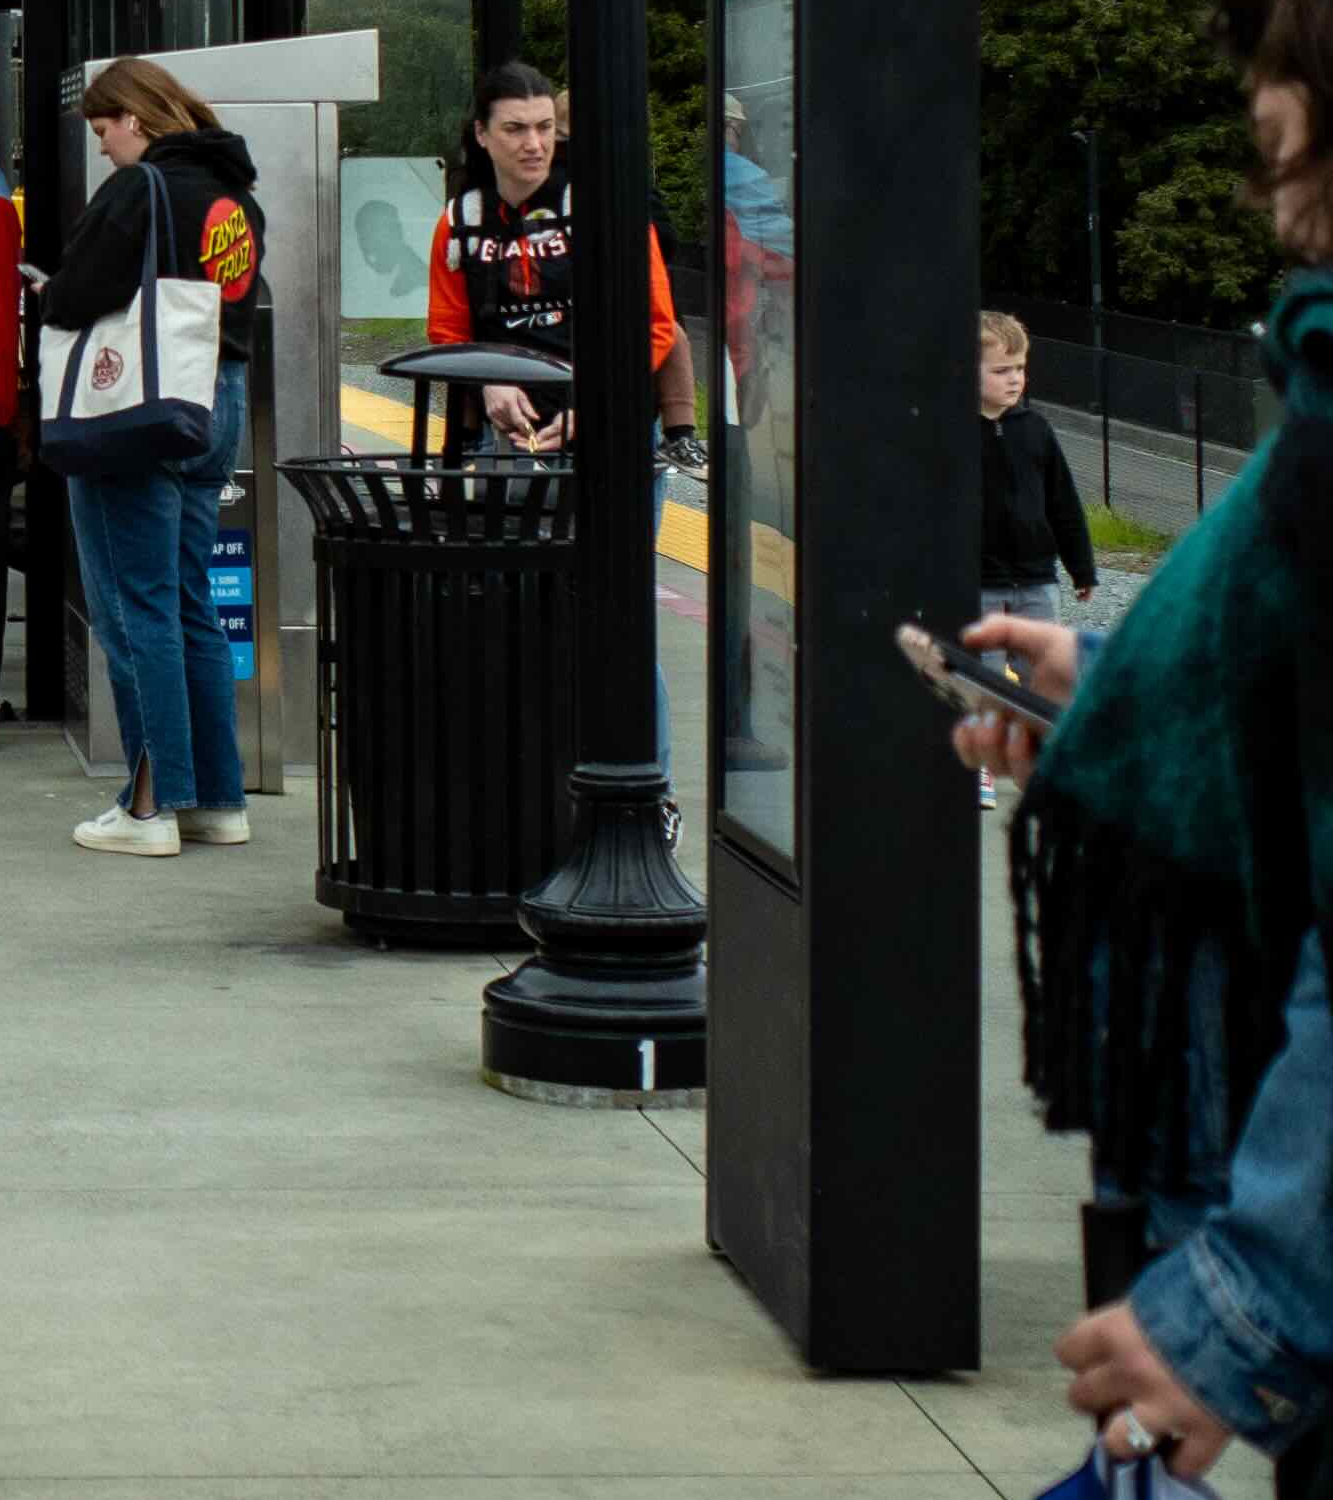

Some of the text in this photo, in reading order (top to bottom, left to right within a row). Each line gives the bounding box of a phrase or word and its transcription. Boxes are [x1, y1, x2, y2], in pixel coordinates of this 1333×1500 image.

[198, 205, 247, 264] SANTA
[214, 238, 251, 286] CRUZ
[480, 237, 566, 262] GIANTS
[500, 298, 573, 314] ASEBALL
[212, 543, 245, 556] AP OFF.
[228, 617, 247, 631] OFF.
[636, 1038, 656, 1091] 1
